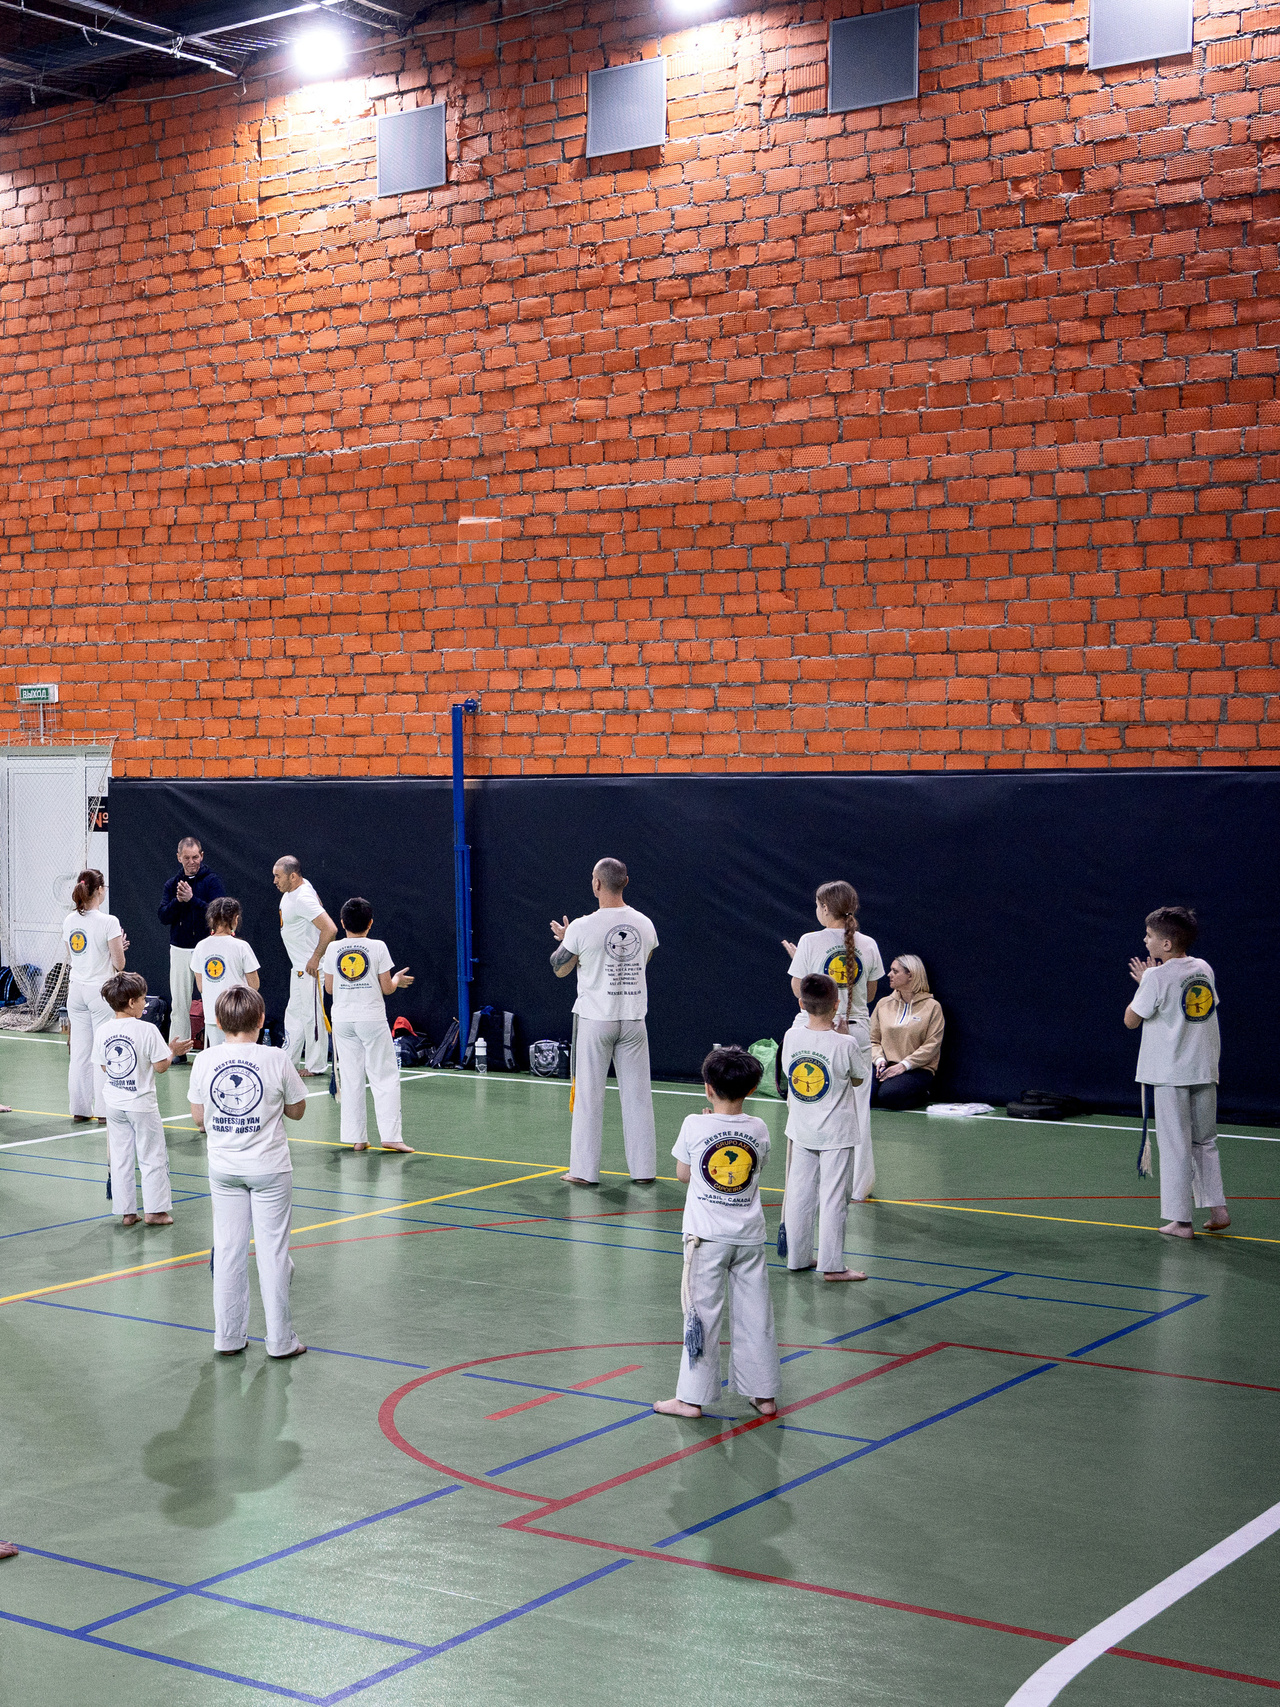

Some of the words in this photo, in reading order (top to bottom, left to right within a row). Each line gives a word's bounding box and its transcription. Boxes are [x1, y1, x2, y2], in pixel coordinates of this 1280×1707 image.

[23, 689, 48, 699] ВЫХОД
[214, 1060, 236, 1072] MESTRE
[237, 1060, 260, 1072] BARRÃO
[246, 1116, 260, 1125] YAN
[704, 1131, 732, 1146] MESTRE
[733, 1131, 760, 1148] BARRÃO
[715, 1140, 738, 1149] GRUPO
[713, 1183, 743, 1193] CAPOEIRA
